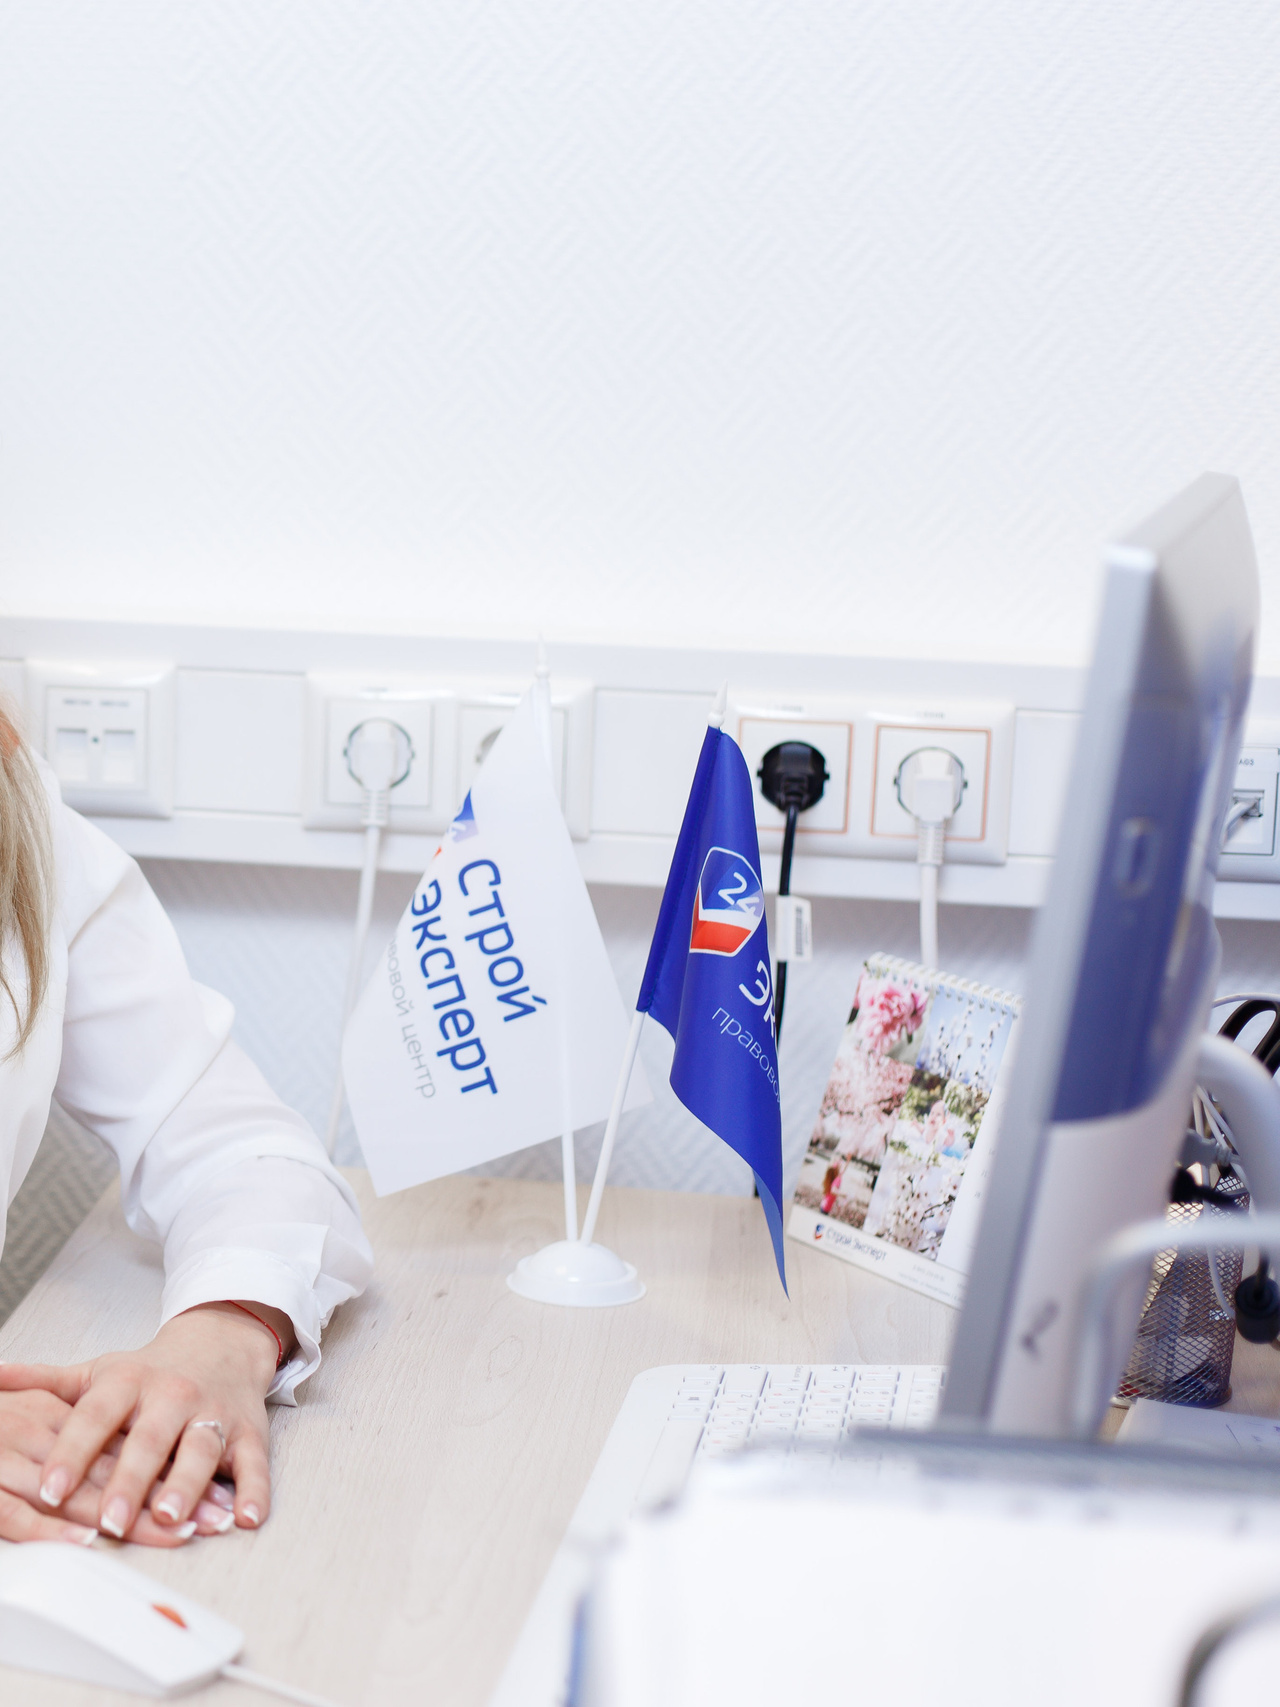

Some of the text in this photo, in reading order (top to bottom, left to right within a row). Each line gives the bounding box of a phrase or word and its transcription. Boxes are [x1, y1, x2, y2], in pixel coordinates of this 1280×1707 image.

[458, 859, 547, 1022] Строй
[717, 871, 760, 917] 24
[411, 878, 498, 1094] Эксперт
[401, 1023, 437, 1099] центр
